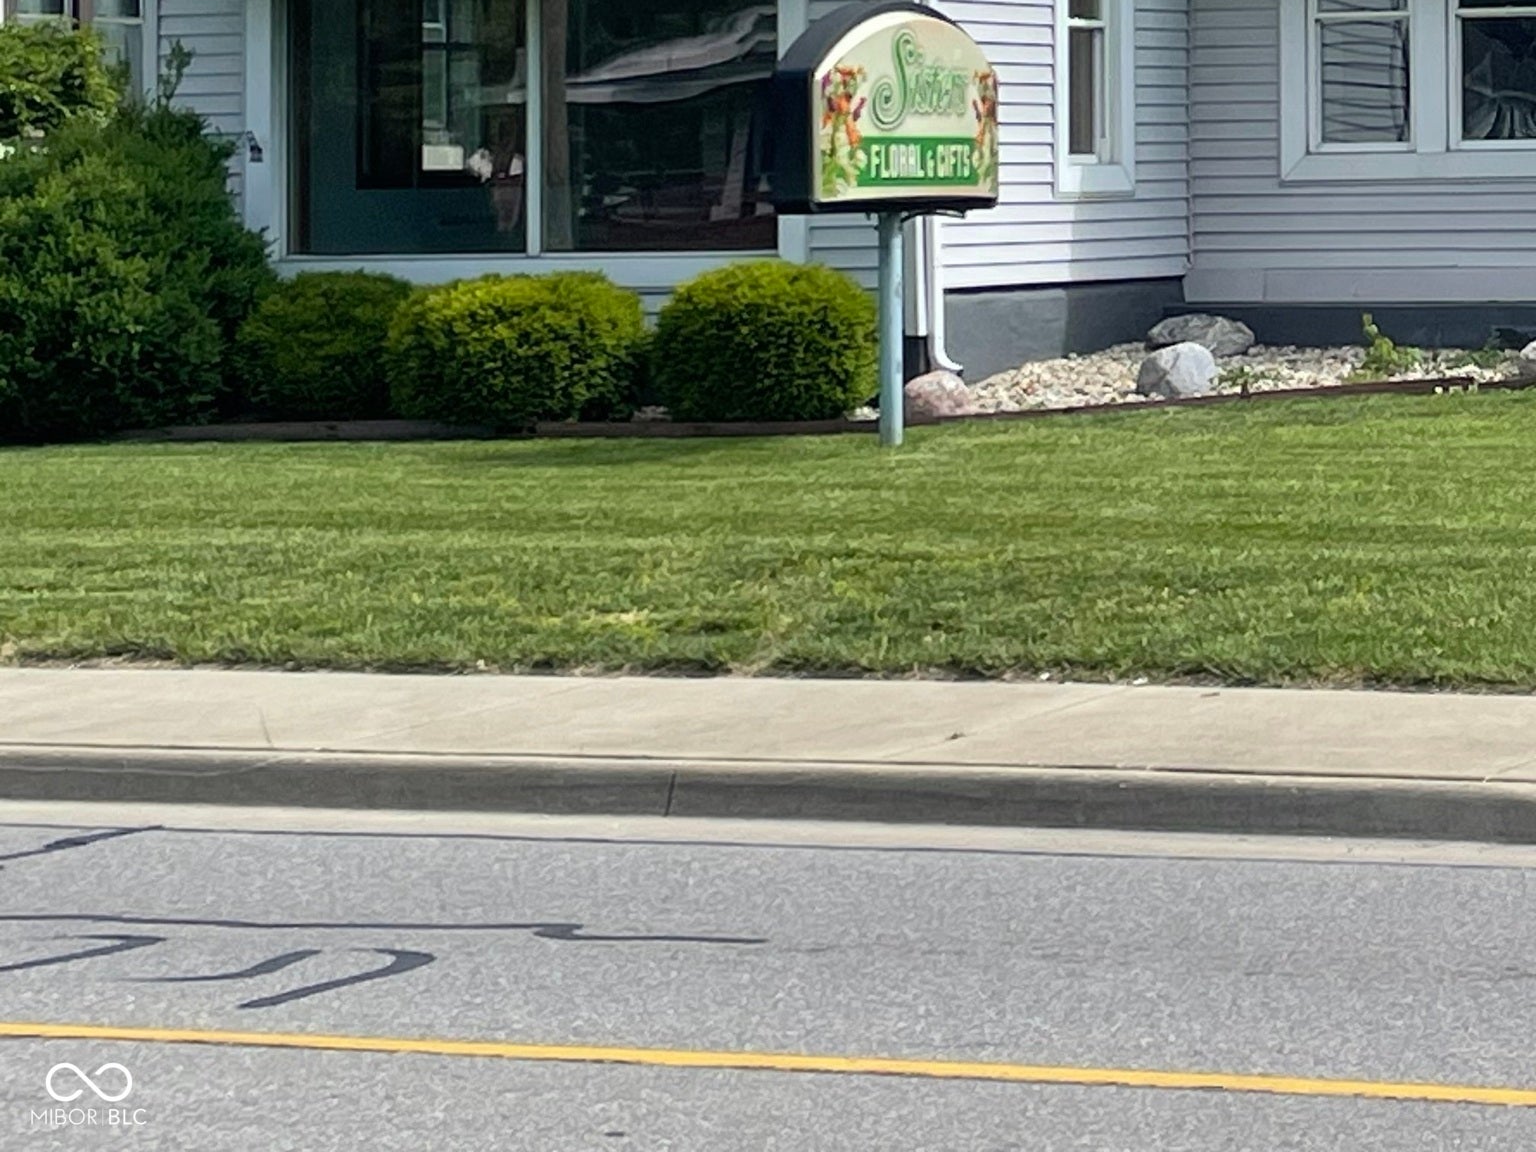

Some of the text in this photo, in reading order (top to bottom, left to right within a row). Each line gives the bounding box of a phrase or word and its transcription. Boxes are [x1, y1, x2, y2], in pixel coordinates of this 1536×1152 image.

[870, 144, 971, 179] FLORAL & GIFTS
